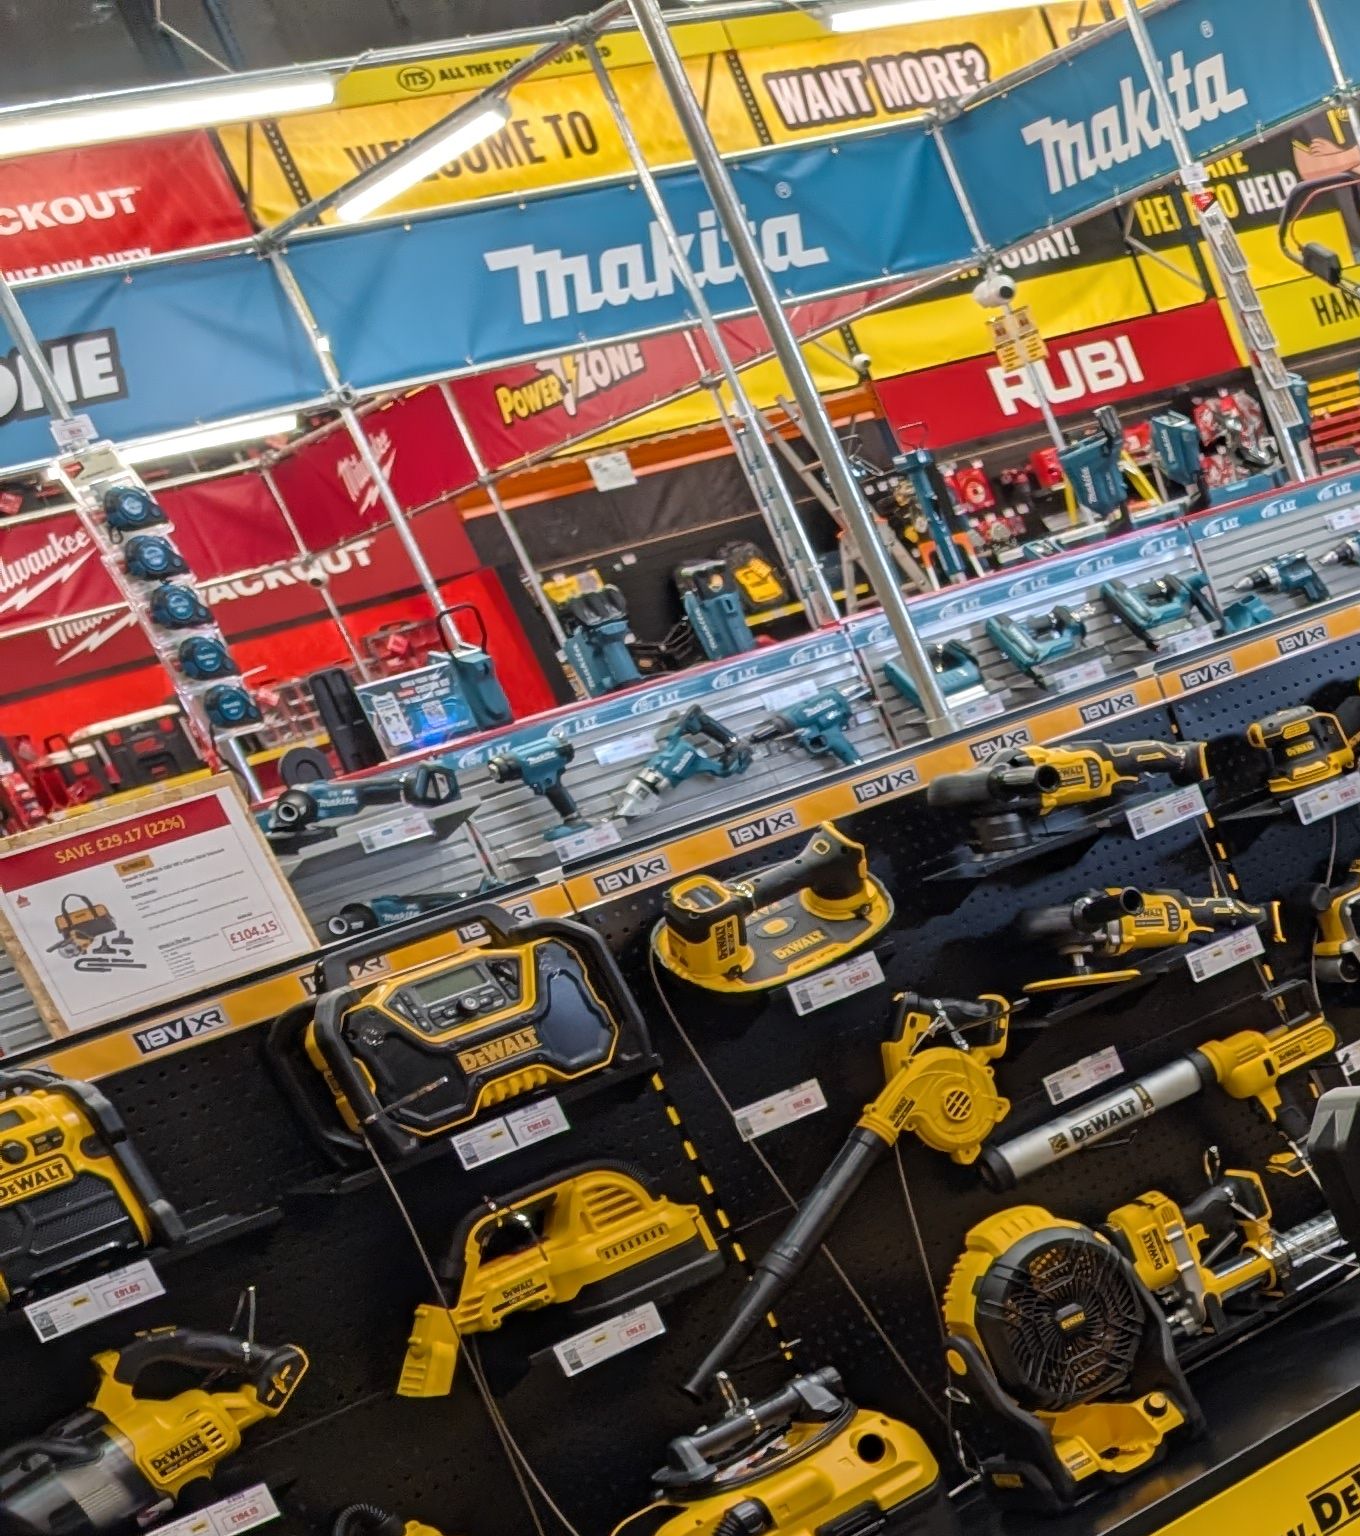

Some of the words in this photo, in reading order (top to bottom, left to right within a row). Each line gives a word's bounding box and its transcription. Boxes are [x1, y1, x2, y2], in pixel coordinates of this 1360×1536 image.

[439, 65, 465, 82] ALL
[768, 65, 864, 124] WANT
[871, 45, 991, 112] MORE?
[543, 111, 599, 160] TO
[1021, 48, 1248, 195] Makita
[484, 204, 830, 325] Makita
[494, 373, 564, 425] POWER
[574, 342, 646, 400] ZONE
[986, 334, 1146, 418] RUBI
[1279, 633, 1304, 656] 18V
[1303, 625, 1328, 646] XR
[1183, 667, 1209, 690] 18V
[1208, 658, 1236, 681] XR
[1081, 701, 1108, 723] 18V
[1107, 692, 1136, 717] XR
[971, 736, 1001, 761] 18V
[1000, 726, 1030, 750] XR
[854, 777, 889, 803] 18V
[888, 767, 918, 791] XR
[54, 843, 96, 866] SAVE
[95, 829, 142, 853] £29.17
[144, 814, 187, 840] (22%)
[728, 819, 766, 848] 18V
[764, 807, 799, 833] XR
[595, 865, 638, 895] 18V
[639, 856, 669, 884] XR
[229, 920, 278, 945] £104.15
[136, 1021, 188, 1054] 18V
[188, 1006, 227, 1036] XR
[458, 1026, 542, 1074] DEWALT
[1070, 1098, 1139, 1144] DEWALT
[502, 1279, 534, 1299] DEWALT
[151, 1434, 204, 1469] DEWALT
